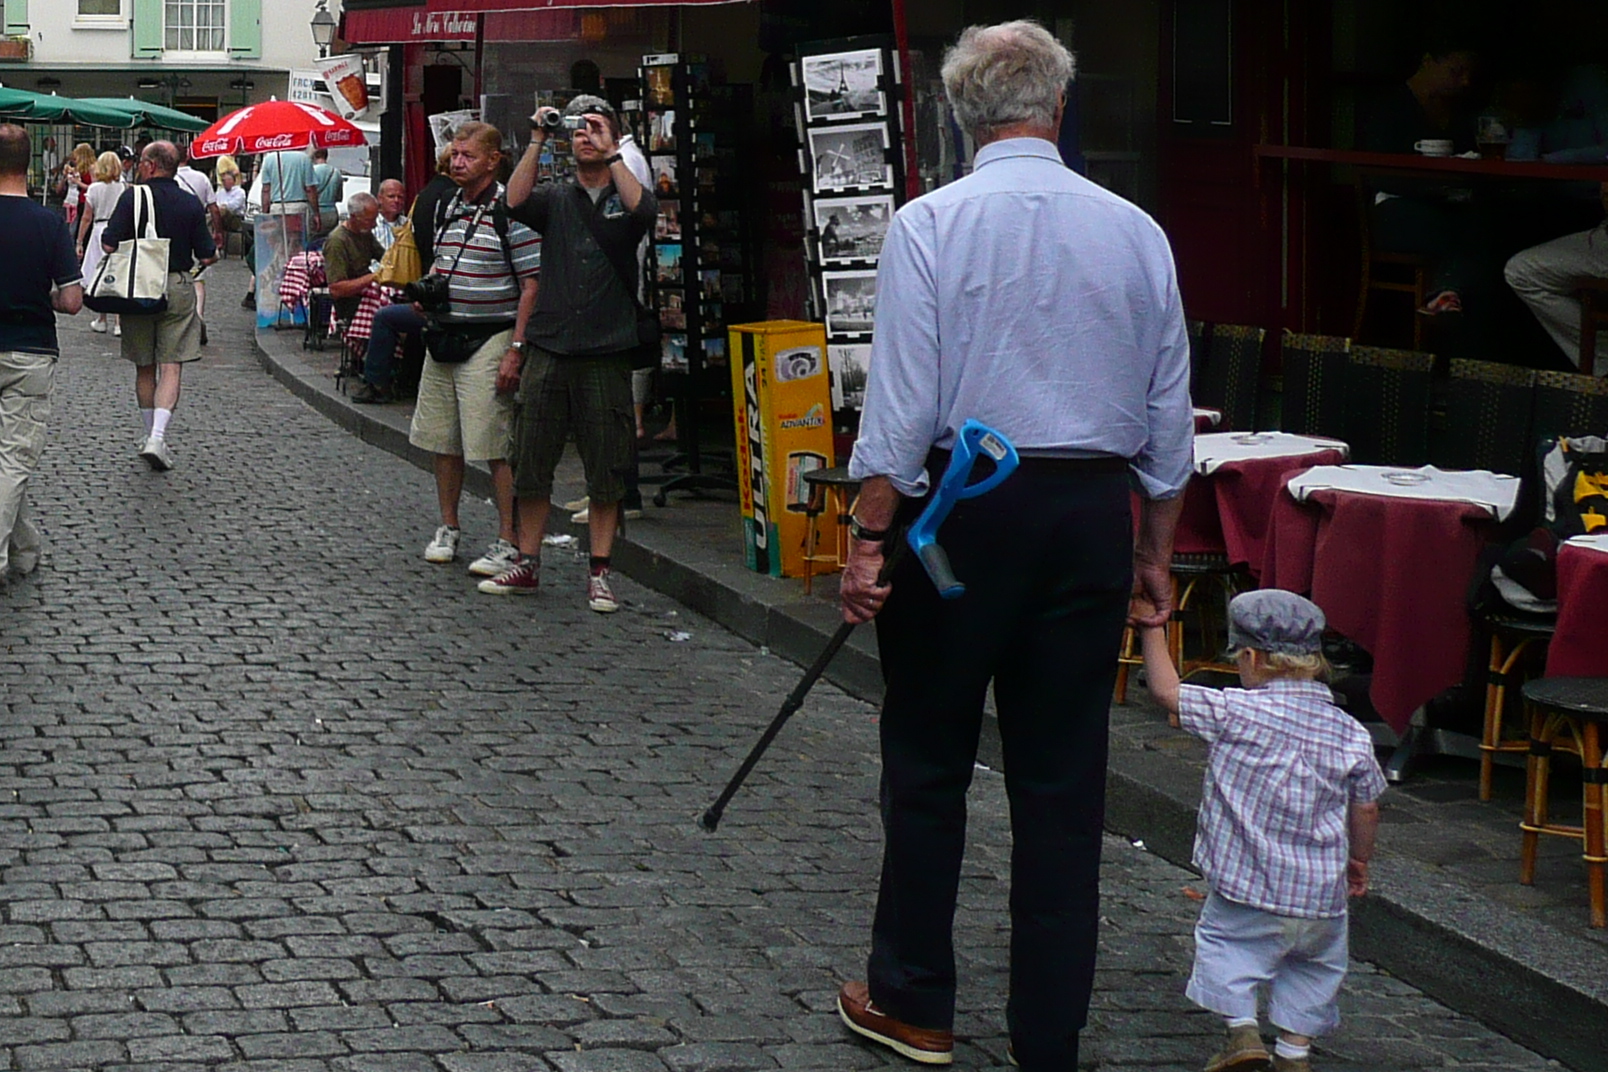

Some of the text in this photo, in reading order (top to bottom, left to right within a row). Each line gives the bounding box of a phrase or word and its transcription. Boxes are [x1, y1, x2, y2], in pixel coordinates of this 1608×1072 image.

[202, 137, 229, 153] Coca-Cola
[255, 133, 293, 149] Coca-Cola
[737, 407, 751, 510] Kodak
[744, 361, 767, 550] ULTRA
